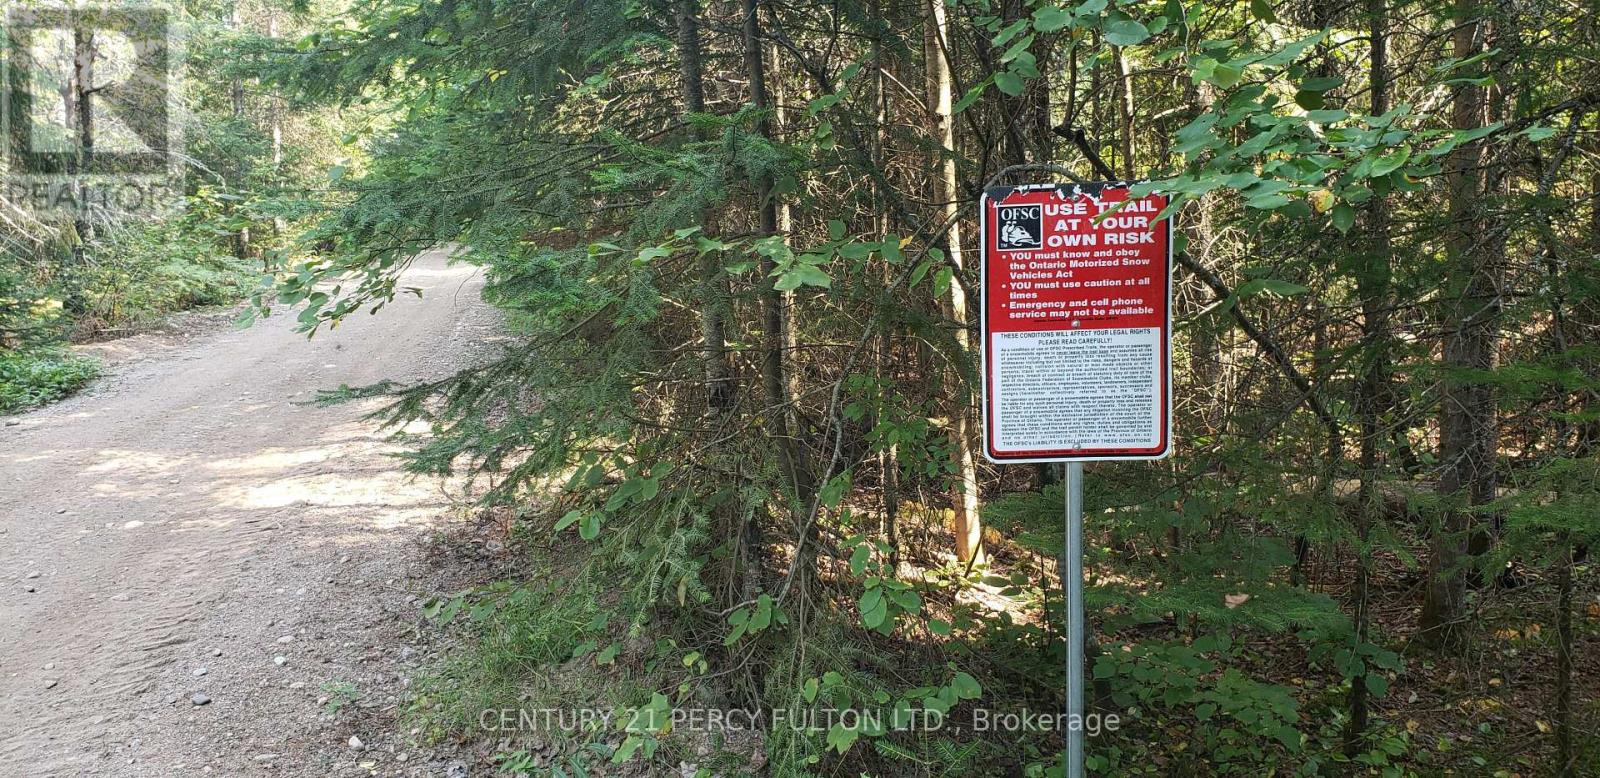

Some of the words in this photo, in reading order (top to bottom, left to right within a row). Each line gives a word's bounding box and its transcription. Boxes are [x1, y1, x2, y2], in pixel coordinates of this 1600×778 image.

[1001, 207, 1040, 221] OFSC
[1045, 203, 1087, 216] USE
[1054, 218, 1082, 231] AT
[1089, 216, 1148, 230] YOUR
[1048, 234, 1096, 247] OWN
[1104, 232, 1155, 245] RISK
[1010, 252, 1032, 260] YOU
[1034, 251, 1060, 259] must
[1094, 249, 1112, 257] and
[1116, 248, 1140, 257] obey
[1029, 261, 1066, 269] Ontario
[1069, 259, 1119, 268] Motorized
[1122, 258, 1150, 266] Snow
[1010, 271, 1053, 279] Vehicles
[1056, 270, 1073, 278] Act
[1084, 279, 1121, 287] caution
[1138, 277, 1150, 285] all
[1010, 301, 1066, 309] Emergency
[1069, 299, 1087, 307] and
[1091, 298, 1109, 306] cell
[1112, 298, 1143, 307] phone
[1010, 310, 1046, 318] service
[1050, 310, 1070, 318] may
[1073, 308, 1090, 316] not
[1093, 308, 1105, 316] be
[1109, 307, 1154, 315] available
